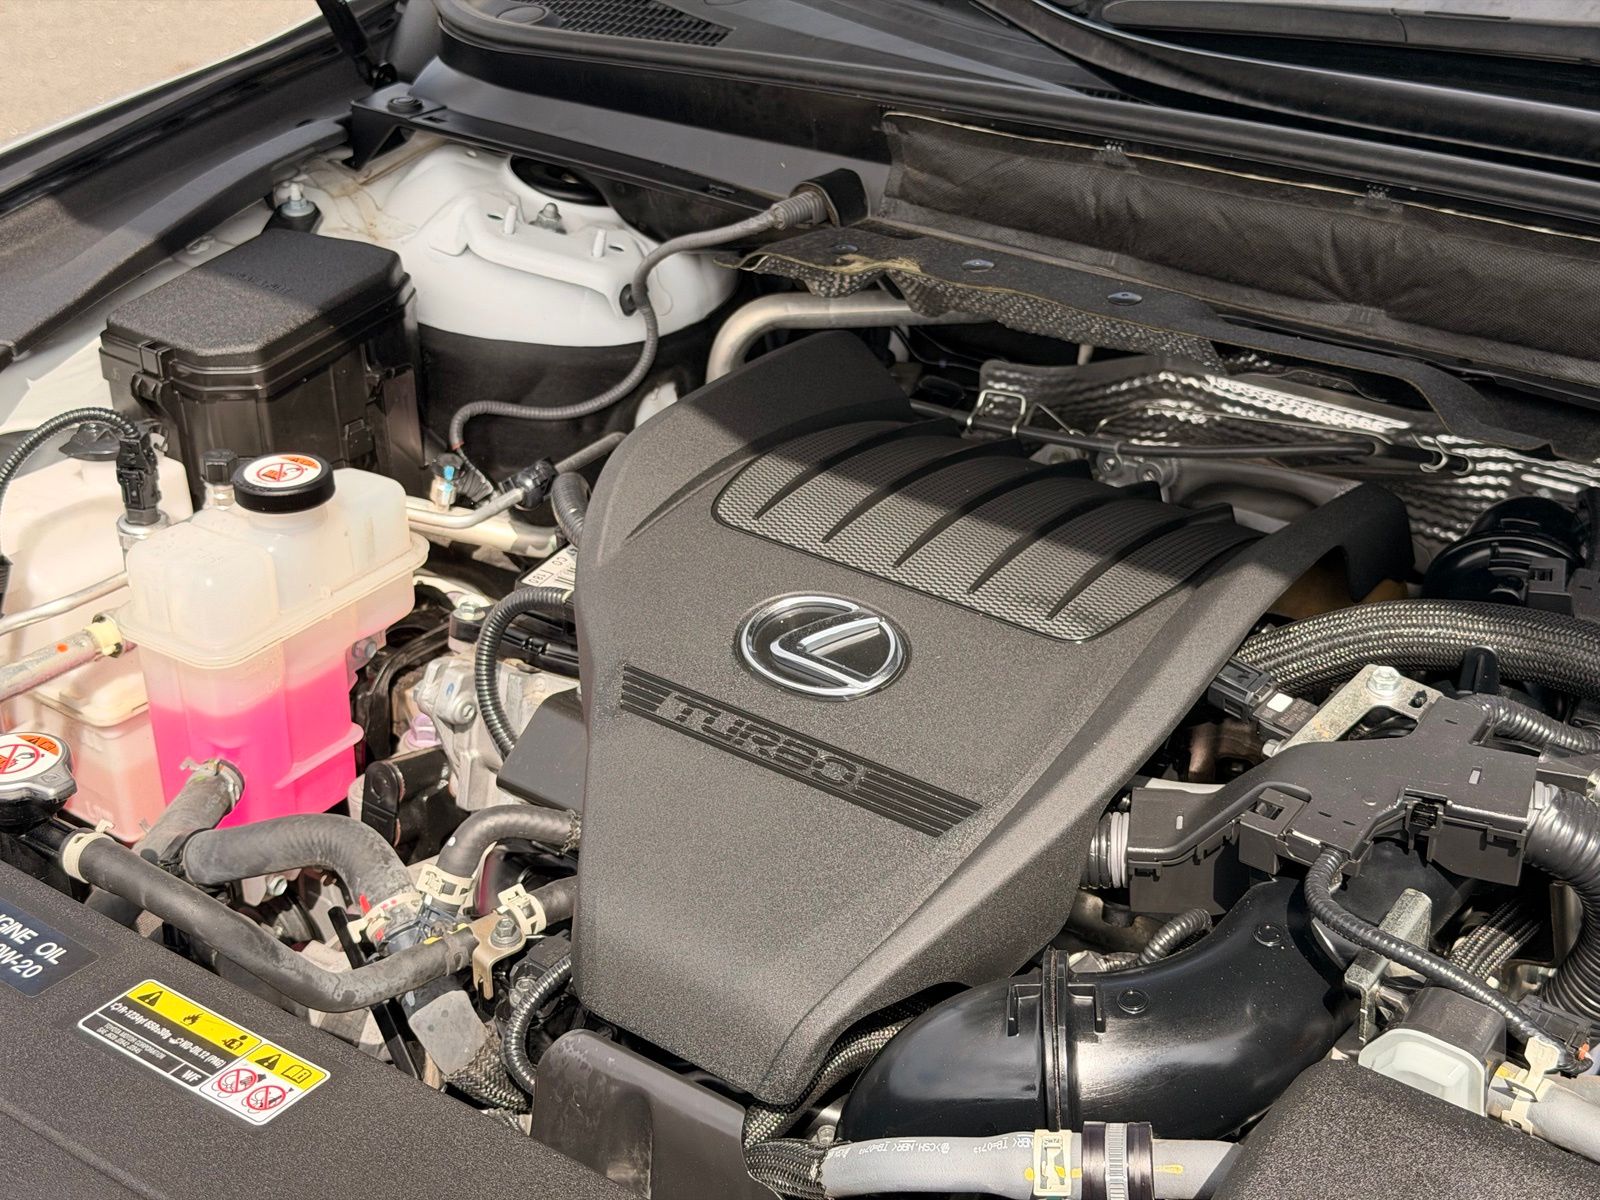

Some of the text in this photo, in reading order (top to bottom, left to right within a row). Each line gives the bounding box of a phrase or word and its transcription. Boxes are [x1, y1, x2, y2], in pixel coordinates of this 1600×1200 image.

[671, 694, 857, 788] TURBO
[35, 942, 67, 965] OIL
[181, 1070, 202, 1082] WF
